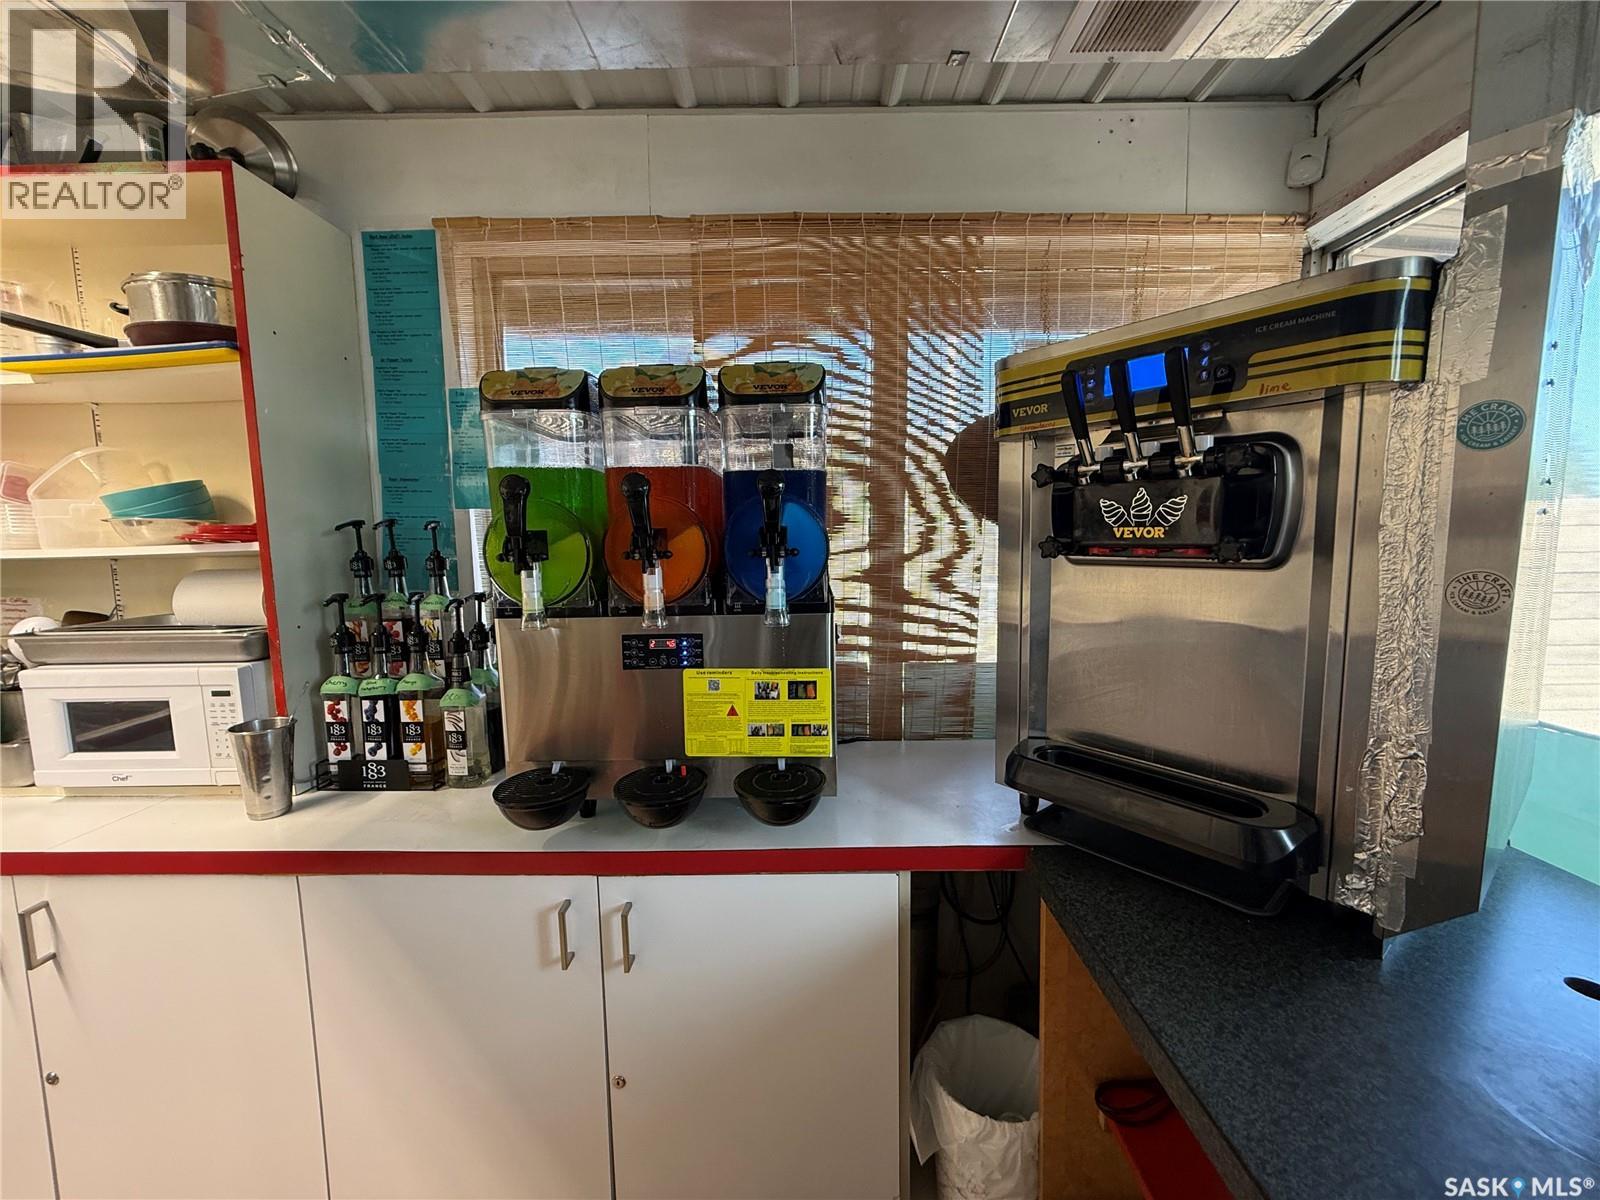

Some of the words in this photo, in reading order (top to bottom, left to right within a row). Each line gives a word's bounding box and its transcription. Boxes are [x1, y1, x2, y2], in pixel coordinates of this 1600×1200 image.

[1255, 325, 1267, 334] ICE
[1269, 318, 1296, 330] CREAM
[1298, 310, 1337, 324] MACHINE
[1259, 382, 1292, 396] lime
[1012, 403, 1049, 418] VEVOR
[1459, 409, 1480, 426] THE
[1480, 402, 1520, 418] CRAFT
[1112, 526, 1166, 539] VEVOR
[1454, 573, 1479, 585] THE
[1483, 574, 1511, 599] CRAFT
